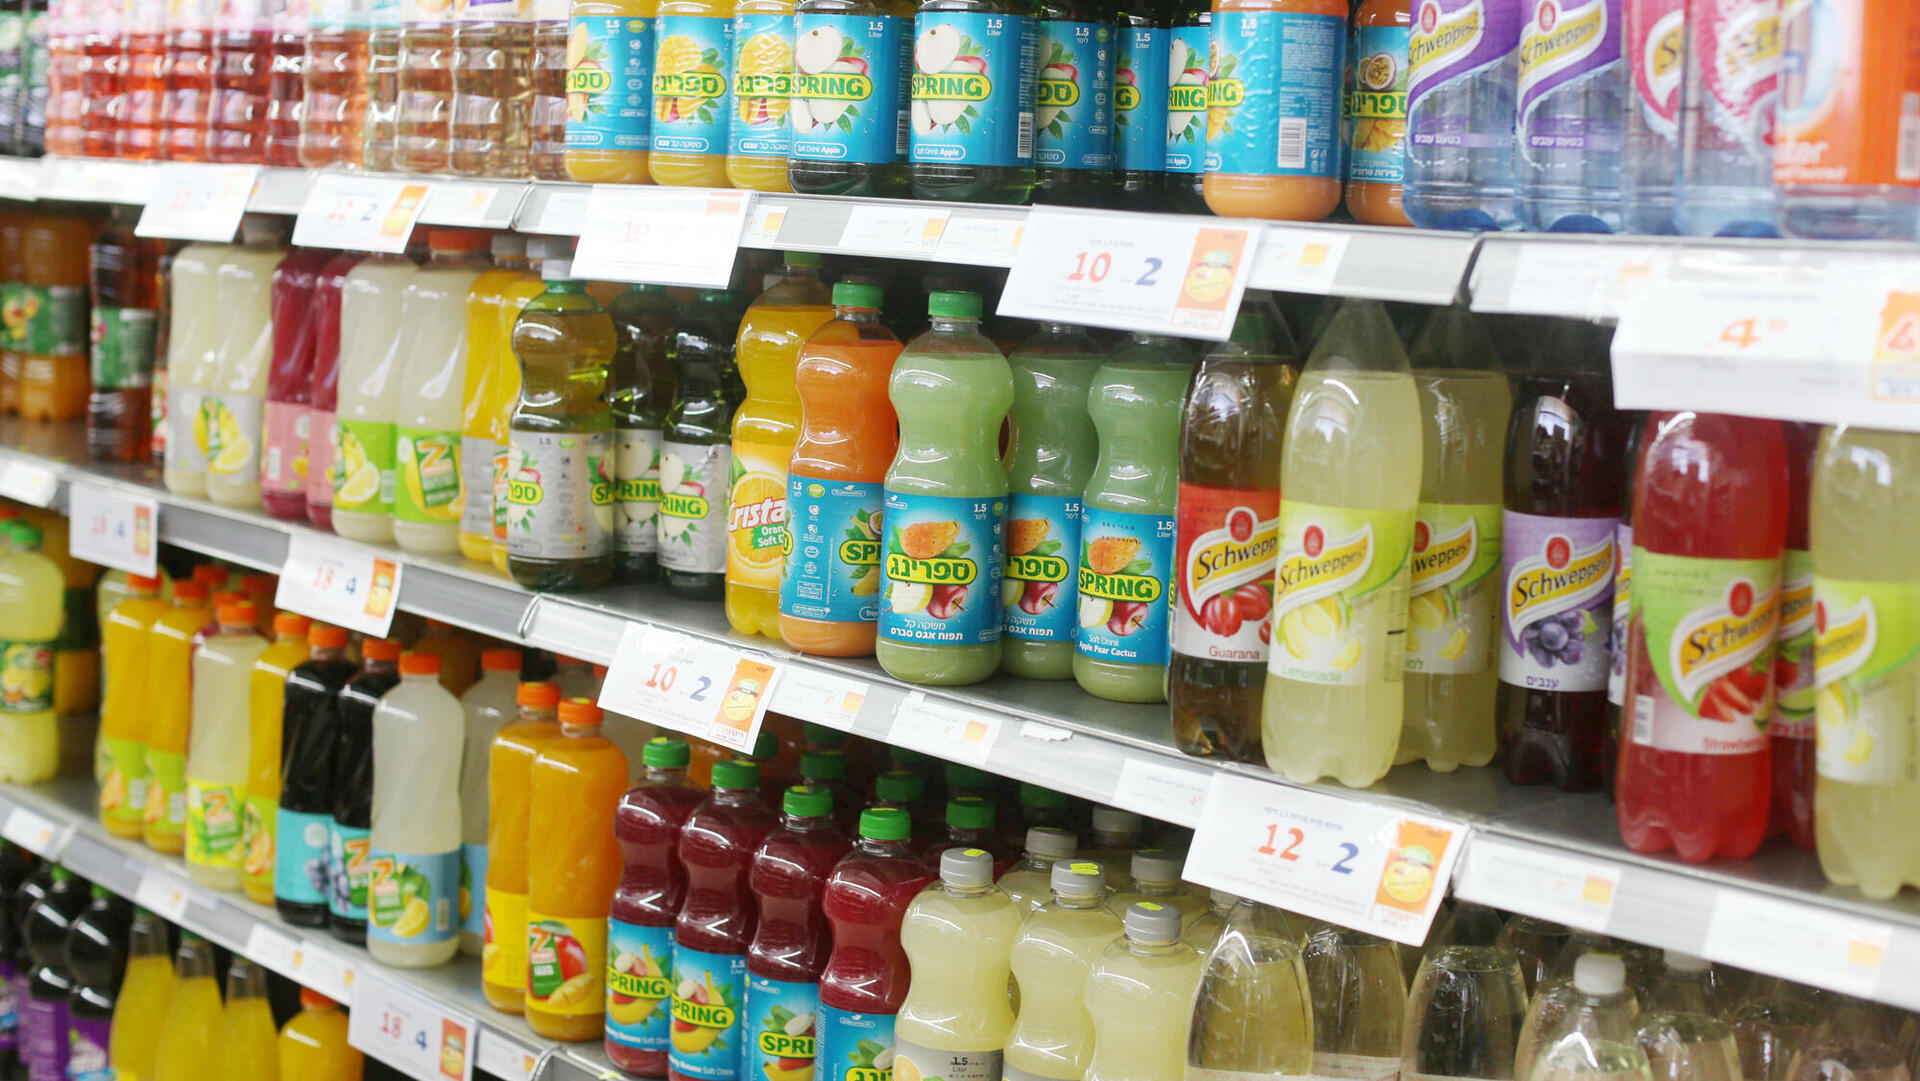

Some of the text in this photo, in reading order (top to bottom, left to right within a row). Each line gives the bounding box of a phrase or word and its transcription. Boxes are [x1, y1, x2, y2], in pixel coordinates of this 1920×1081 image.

[868, 21, 884, 31] 1.5
[986, 18, 1003, 29] 1.5
[1240, 18, 1258, 29] 1.5
[986, 29, 1002, 37] Liter
[1075, 27, 1089, 37] 1.5
[1136, 33, 1151, 42] 1.5
[736, 75, 791, 94] פרינג
[793, 77, 865, 97] SPRING
[912, 77, 983, 97] SPRING
[821, 146, 841, 155] Apple
[940, 149, 960, 158] Apple
[1067, 251, 1162, 286] 10 2
[1719, 317, 1763, 350] 4
[973, 503, 987, 512] 1.5
[1064, 502, 1079, 512] 1.5
[761, 525, 784, 536] Oran
[1157, 521, 1172, 531] 1.5
[757, 534, 777, 547] Soft
[1156, 530, 1171, 538] Liter
[1196, 536, 1279, 581] Schwepp
[891, 556, 970, 581] ספרינג
[1006, 557, 1061, 578] ספרי
[1278, 549, 1363, 595] Schweppes
[1079, 571, 1153, 598] SPRING
[1514, 558, 1609, 608] Schweppes
[904, 618, 946, 630] משקה קל
[890, 627, 963, 640] תפוח אגס סברס
[1009, 627, 1028, 635] אגס
[1029, 628, 1054, 637] תפוח
[1100, 636, 1120, 647] Drink
[1079, 641, 1137, 658] Apple Pear Cactus
[1209, 645, 1260, 660] Guarana
[1281, 666, 1342, 682] Lemonade
[645, 664, 712, 702] 10 2
[1525, 675, 1559, 688] ענבים
[1257, 823, 1359, 875] 12 2
[731, 960, 745, 968] 1.5
[607, 970, 666, 996] PRING
[671, 1000, 728, 1025] PRING
[952, 1057, 968, 1066] 1.5
